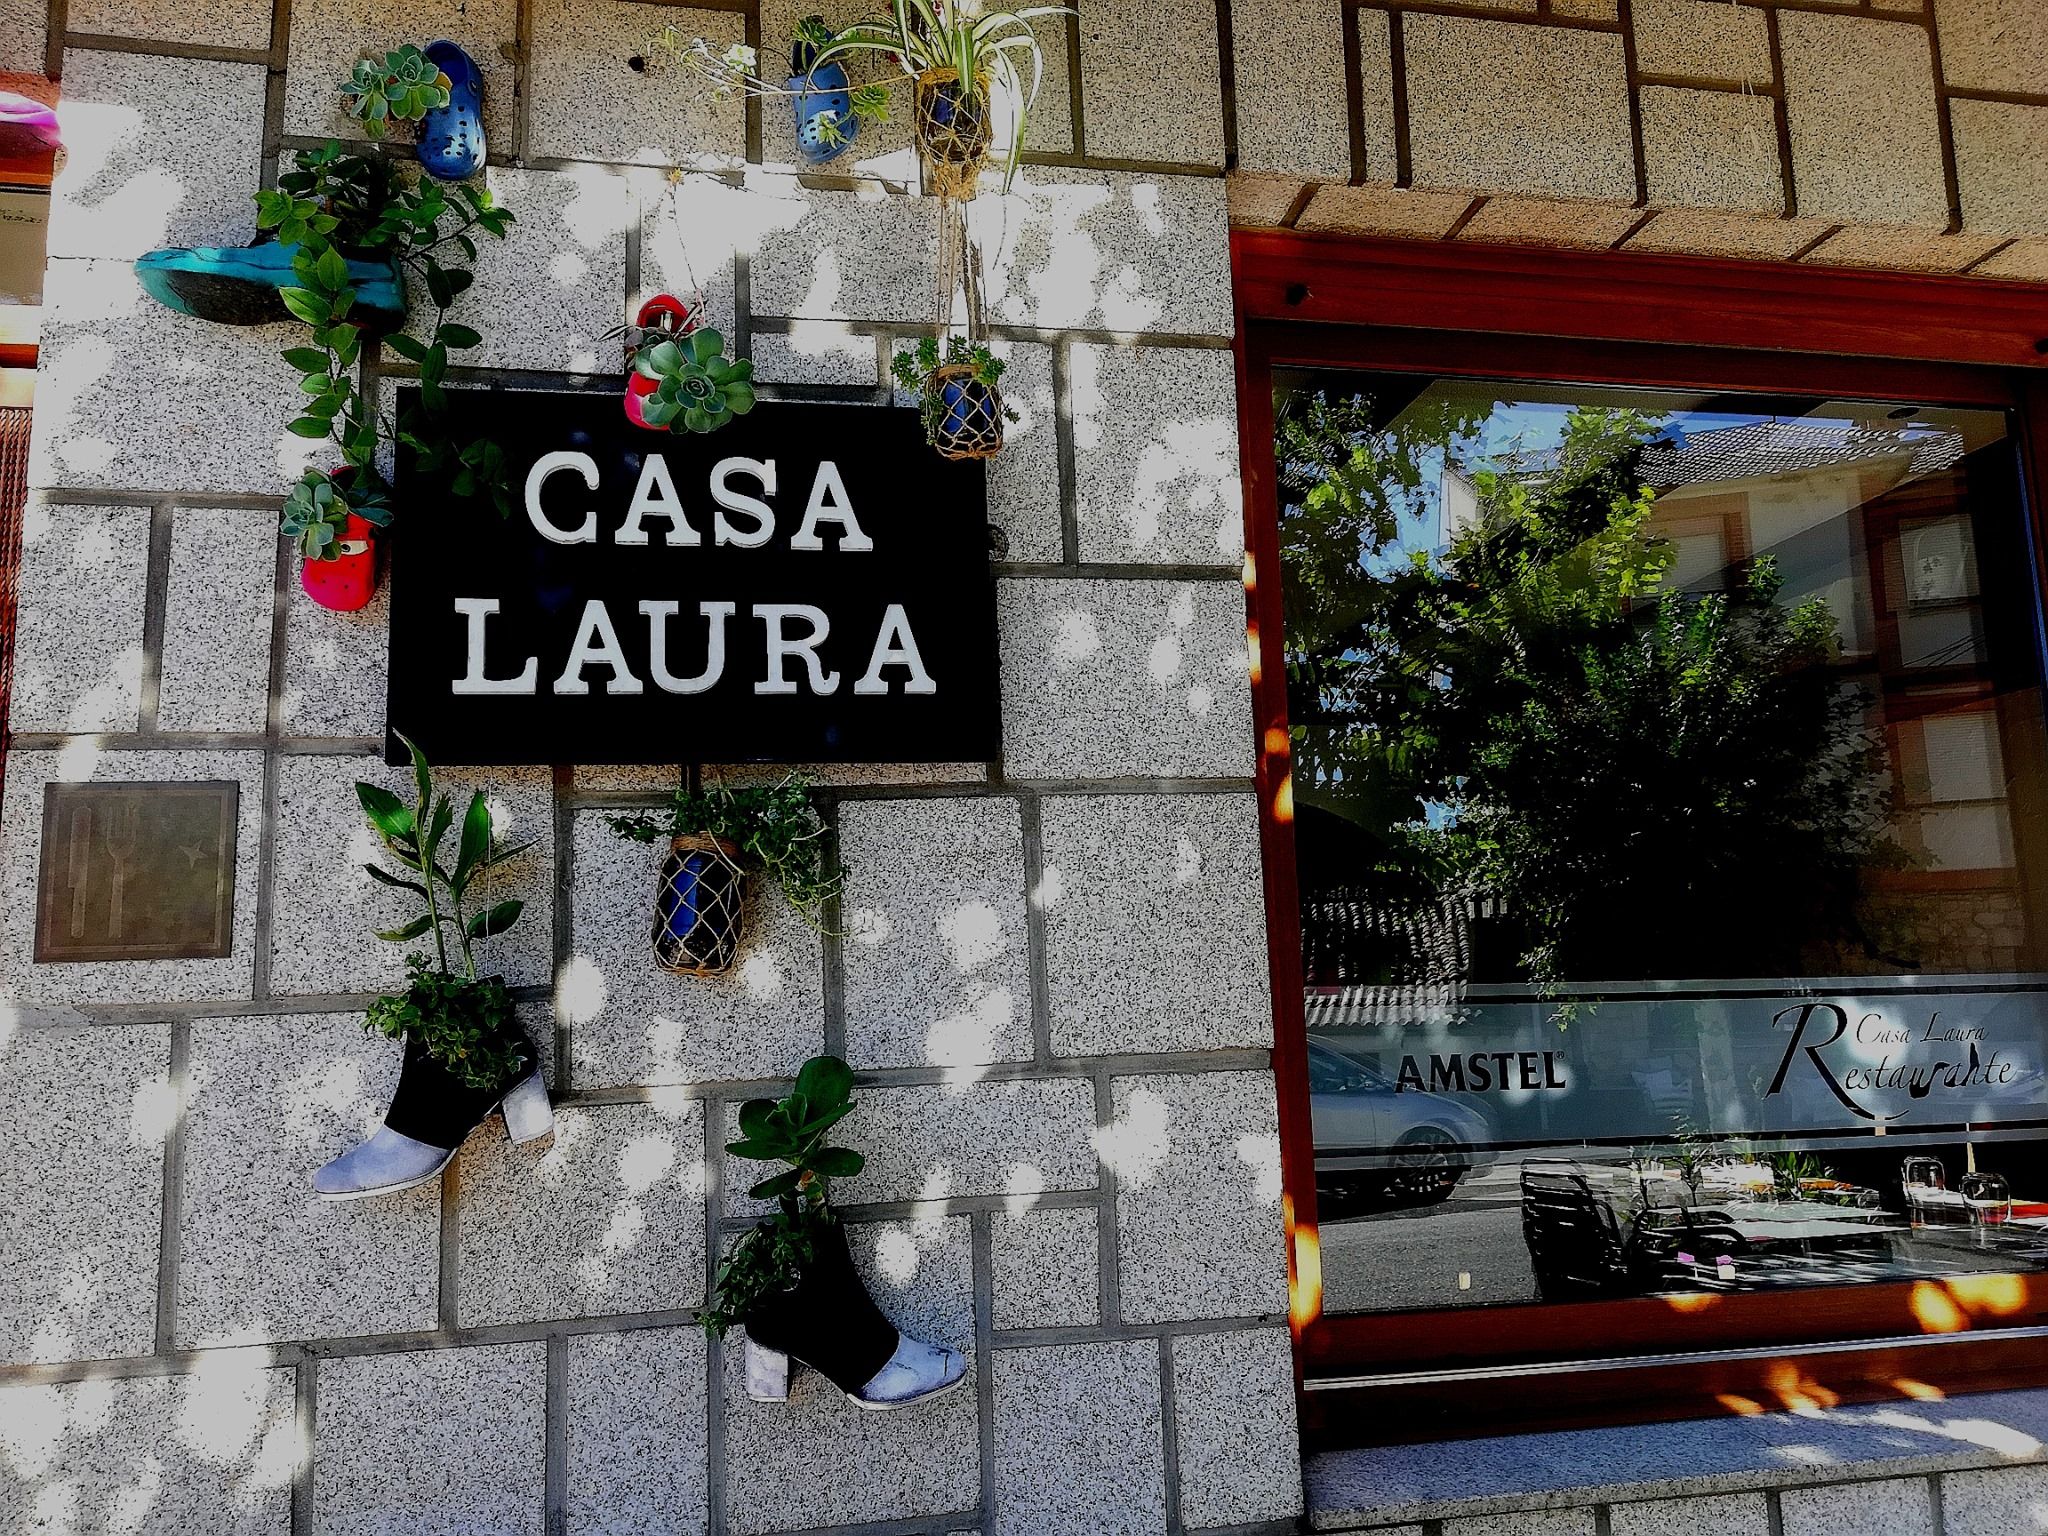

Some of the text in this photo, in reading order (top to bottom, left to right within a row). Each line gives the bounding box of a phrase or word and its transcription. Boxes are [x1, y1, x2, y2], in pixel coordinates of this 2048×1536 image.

[524, 451, 873, 551] CASA
[452, 598, 936, 695] LAURA
[1765, 1003, 2016, 1120] Restaurante
[1856, 1011, 1990, 1043] Casa Laura
